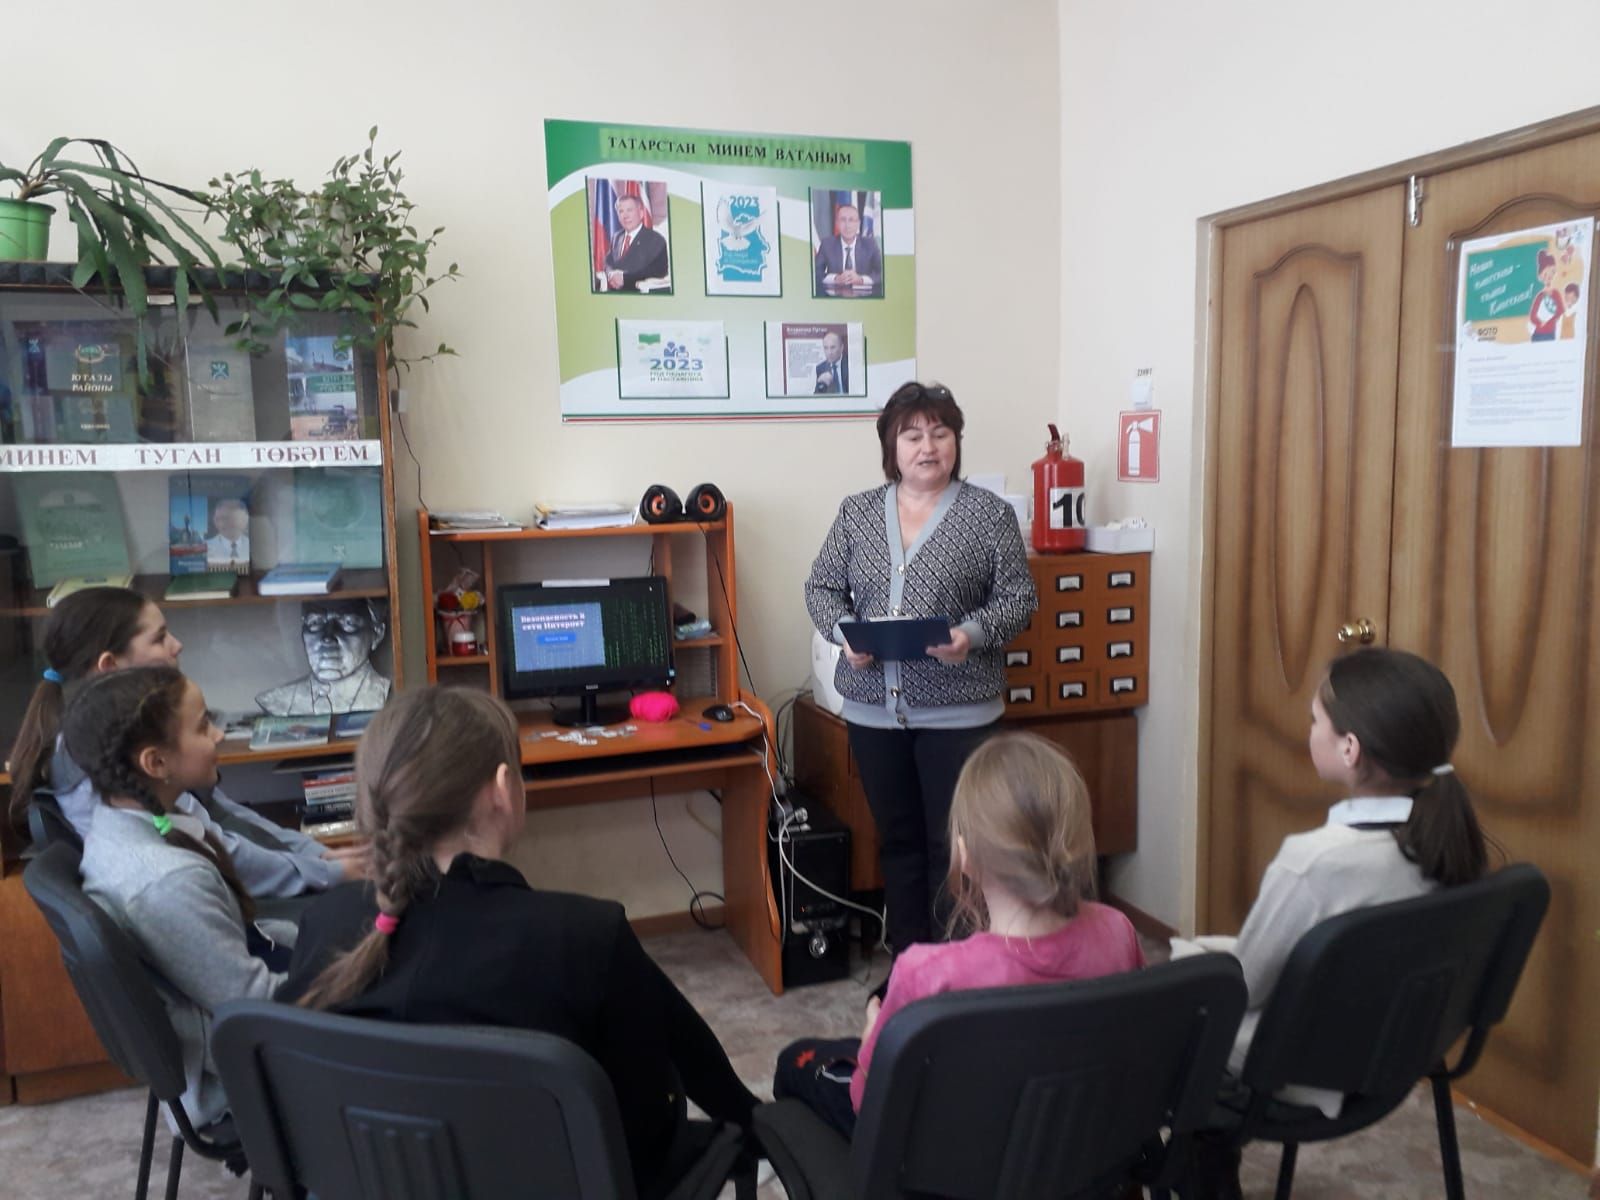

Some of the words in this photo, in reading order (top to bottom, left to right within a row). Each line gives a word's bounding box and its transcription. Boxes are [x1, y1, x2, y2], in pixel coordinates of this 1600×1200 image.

[607, 136, 696, 155] ТАТАРСТАН
[707, 143, 767, 160] МИНЕМ
[775, 148, 852, 166] ВАТАНЫМ
[729, 195, 760, 208] 2023
[649, 358, 704, 371] 2023
[72, 382, 113, 392] РАЙОНЫ
[135, 447, 221, 465] ТУГАН
[251, 445, 369, 463] ТӨБӘГЕМ
